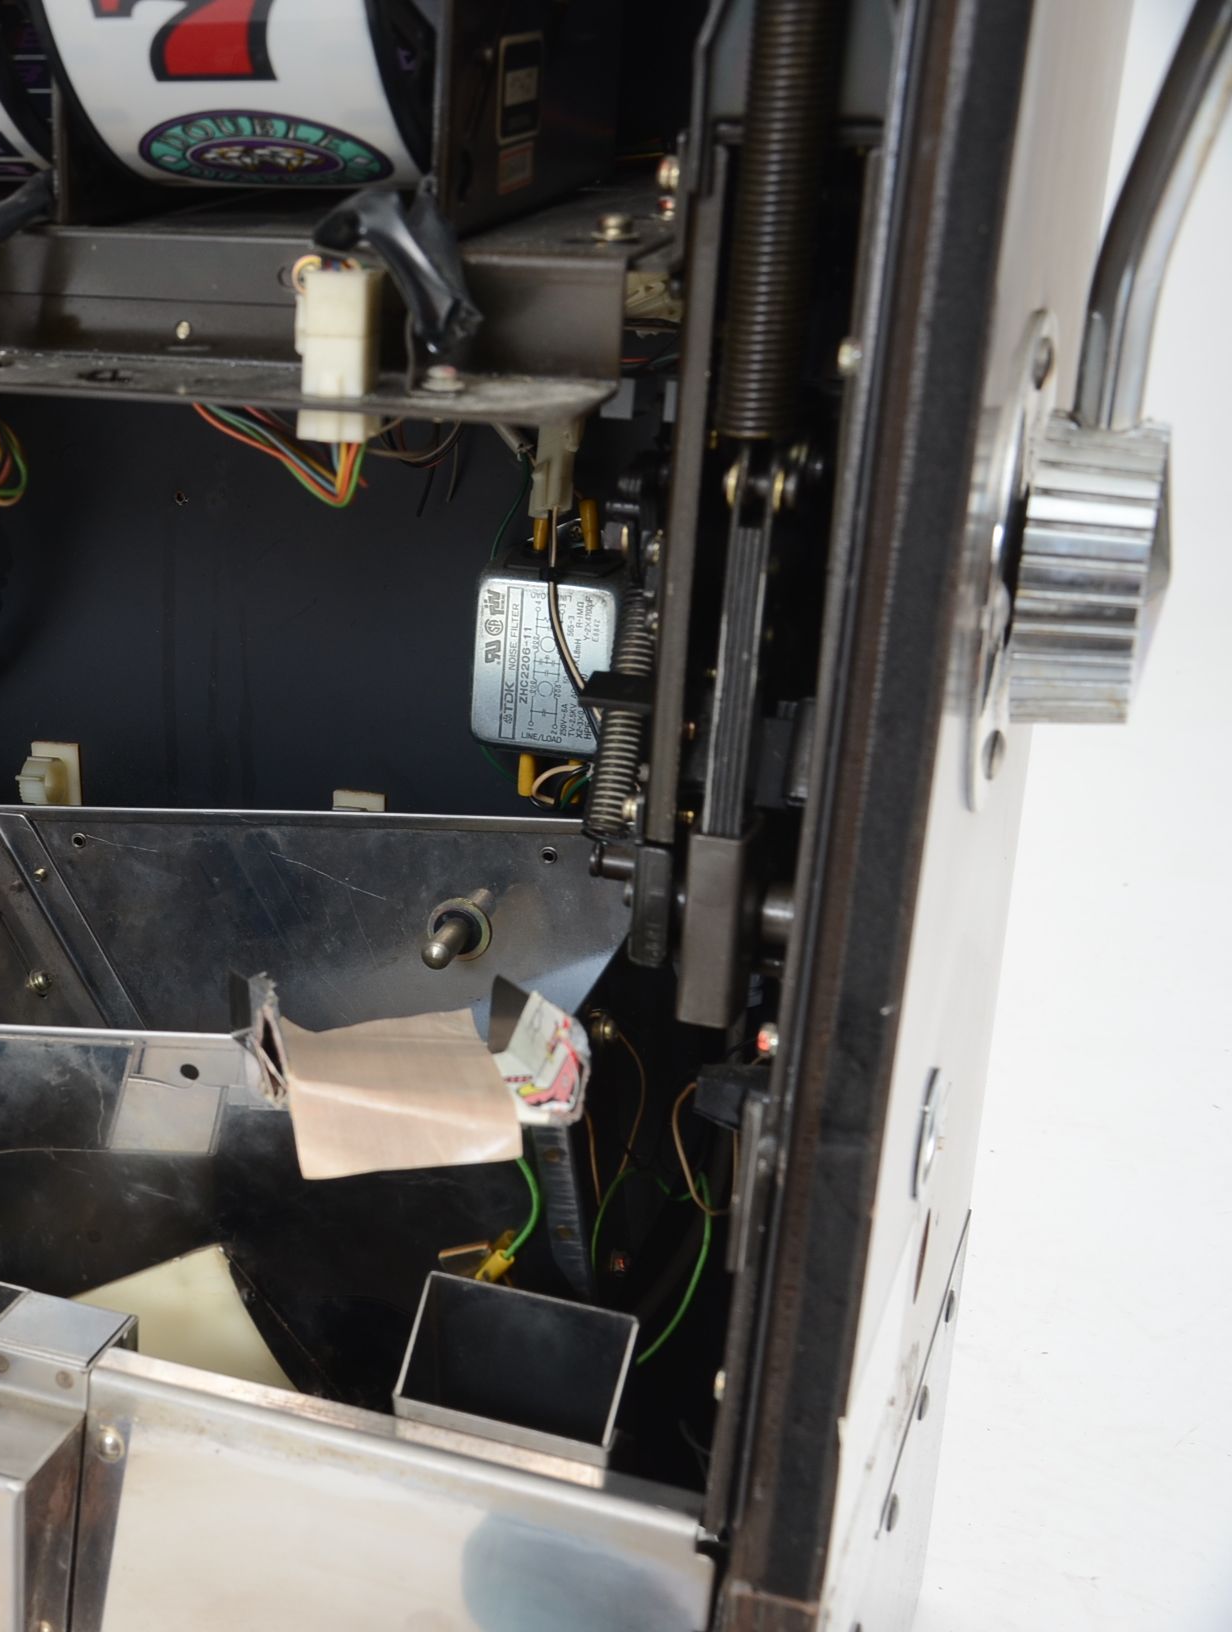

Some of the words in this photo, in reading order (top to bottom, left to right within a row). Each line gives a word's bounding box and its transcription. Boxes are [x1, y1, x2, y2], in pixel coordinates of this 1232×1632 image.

[158, 116, 341, 150] DOUBLE
[510, 603, 520, 638] FILTER
[508, 642, 517, 670] NOISE
[519, 627, 532, 704] ZHC2206-11
[503, 681, 515, 713] TDK
